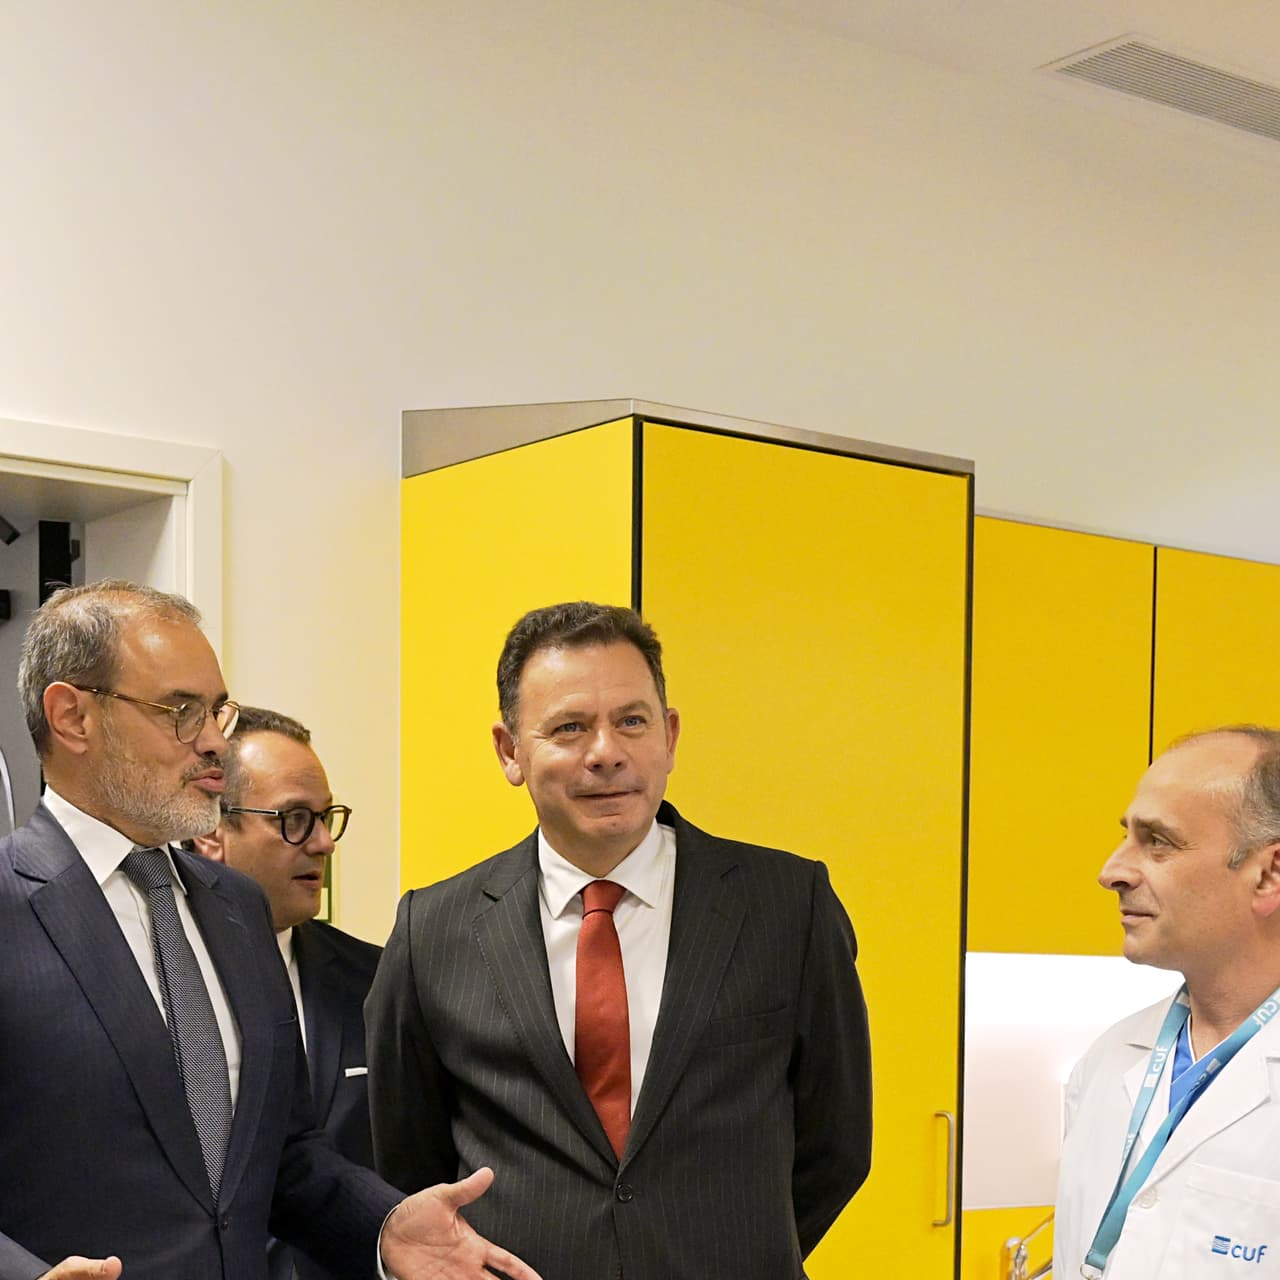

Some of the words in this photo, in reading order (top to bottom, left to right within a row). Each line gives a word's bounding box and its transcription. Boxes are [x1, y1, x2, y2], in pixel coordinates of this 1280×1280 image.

[1251, 998, 1278, 1027] cuf
[1153, 1046, 1168, 1073] cuf
[1231, 1244, 1268, 1264] cuf
